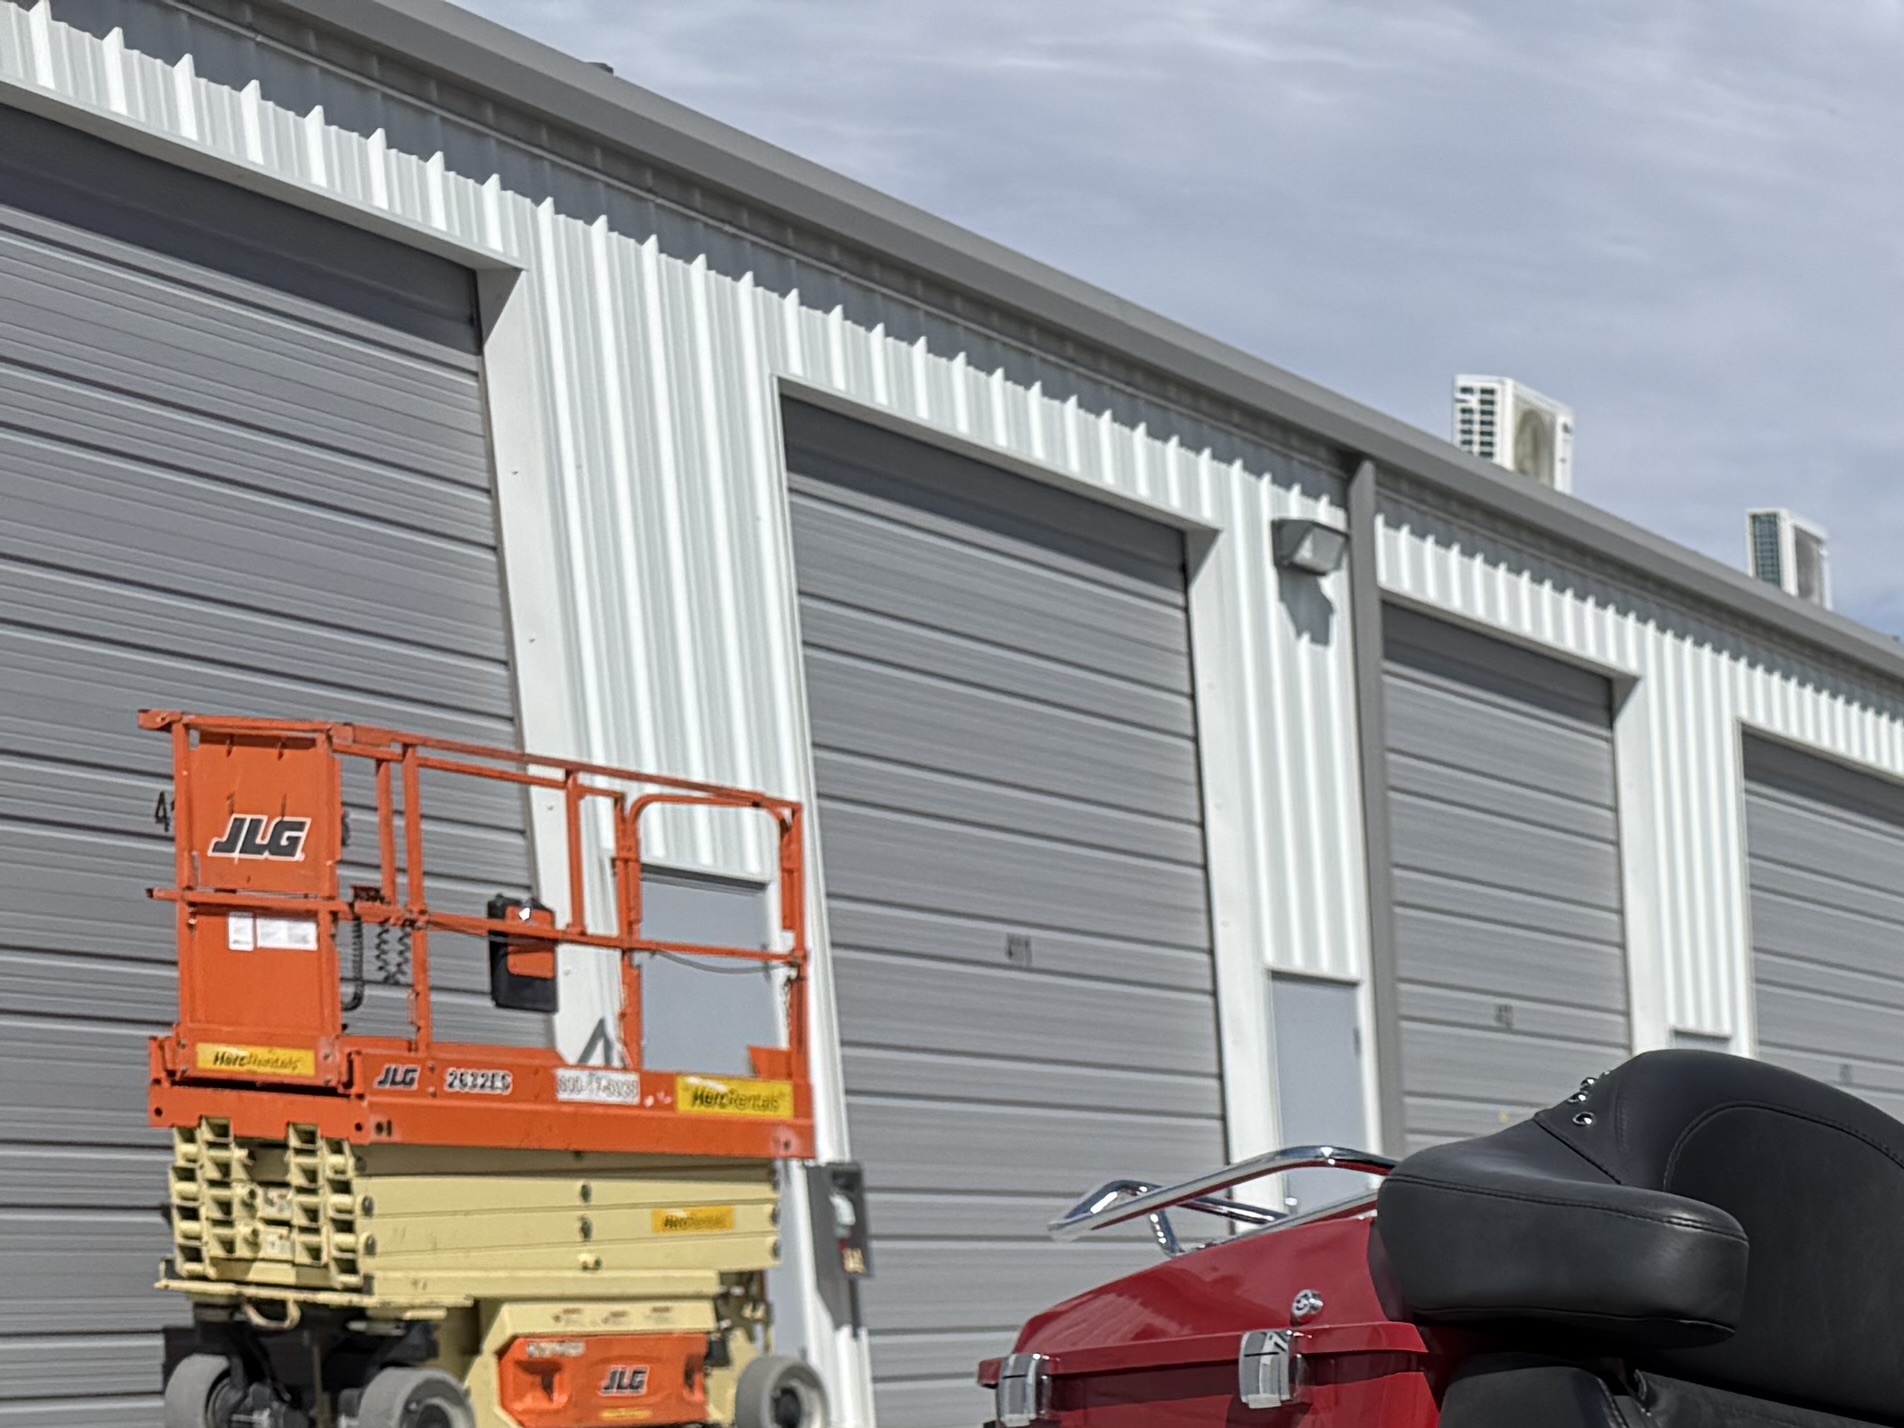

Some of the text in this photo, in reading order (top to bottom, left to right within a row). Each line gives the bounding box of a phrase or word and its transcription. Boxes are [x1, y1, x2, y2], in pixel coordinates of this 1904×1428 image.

[211, 817, 309, 859] JLG
[377, 1066, 418, 1088] JLG
[601, 1368, 647, 1391] JLG
